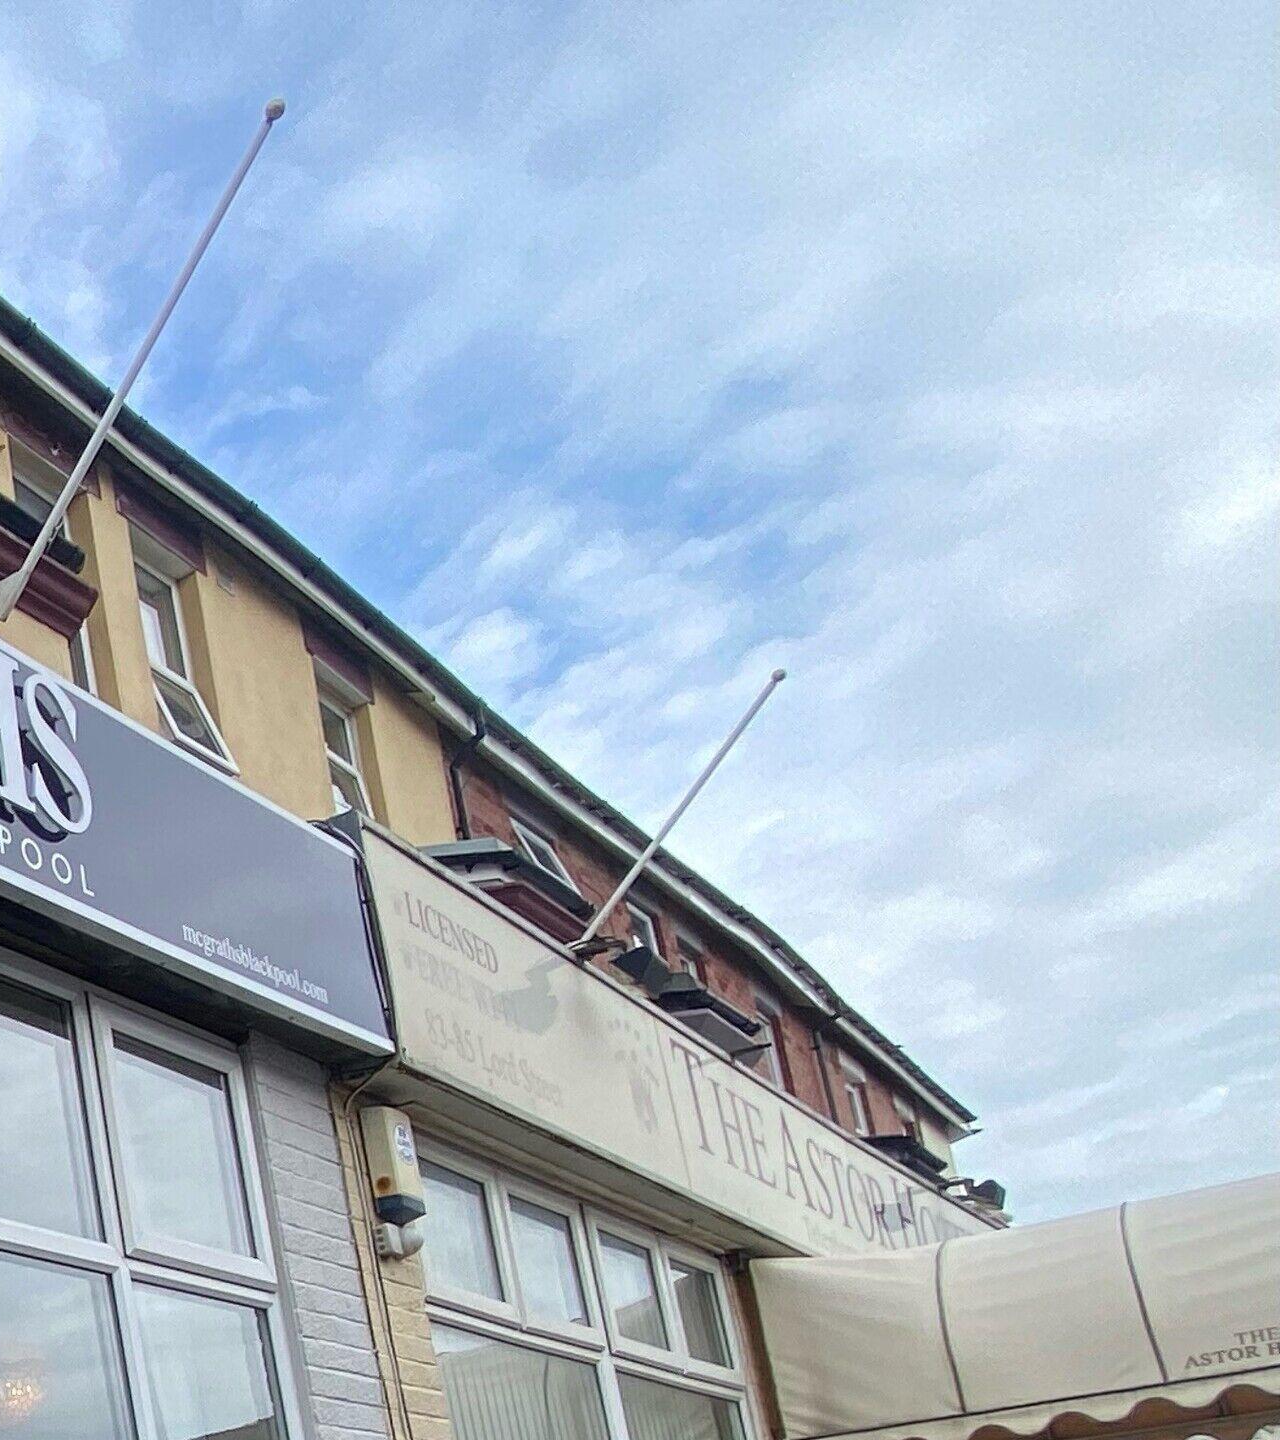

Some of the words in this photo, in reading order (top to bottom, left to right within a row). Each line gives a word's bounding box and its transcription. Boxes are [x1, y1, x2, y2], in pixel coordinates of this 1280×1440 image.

[182, 923, 329, 1005] mcgrathsblackpool.com
[403, 891, 499, 974] LICENSED
[669, 1036, 777, 1190] THE
[780, 1108, 896, 1250] ASTOR
[1184, 1345, 1260, 1370] ASTOR
[1233, 1326, 1280, 1345] THE
